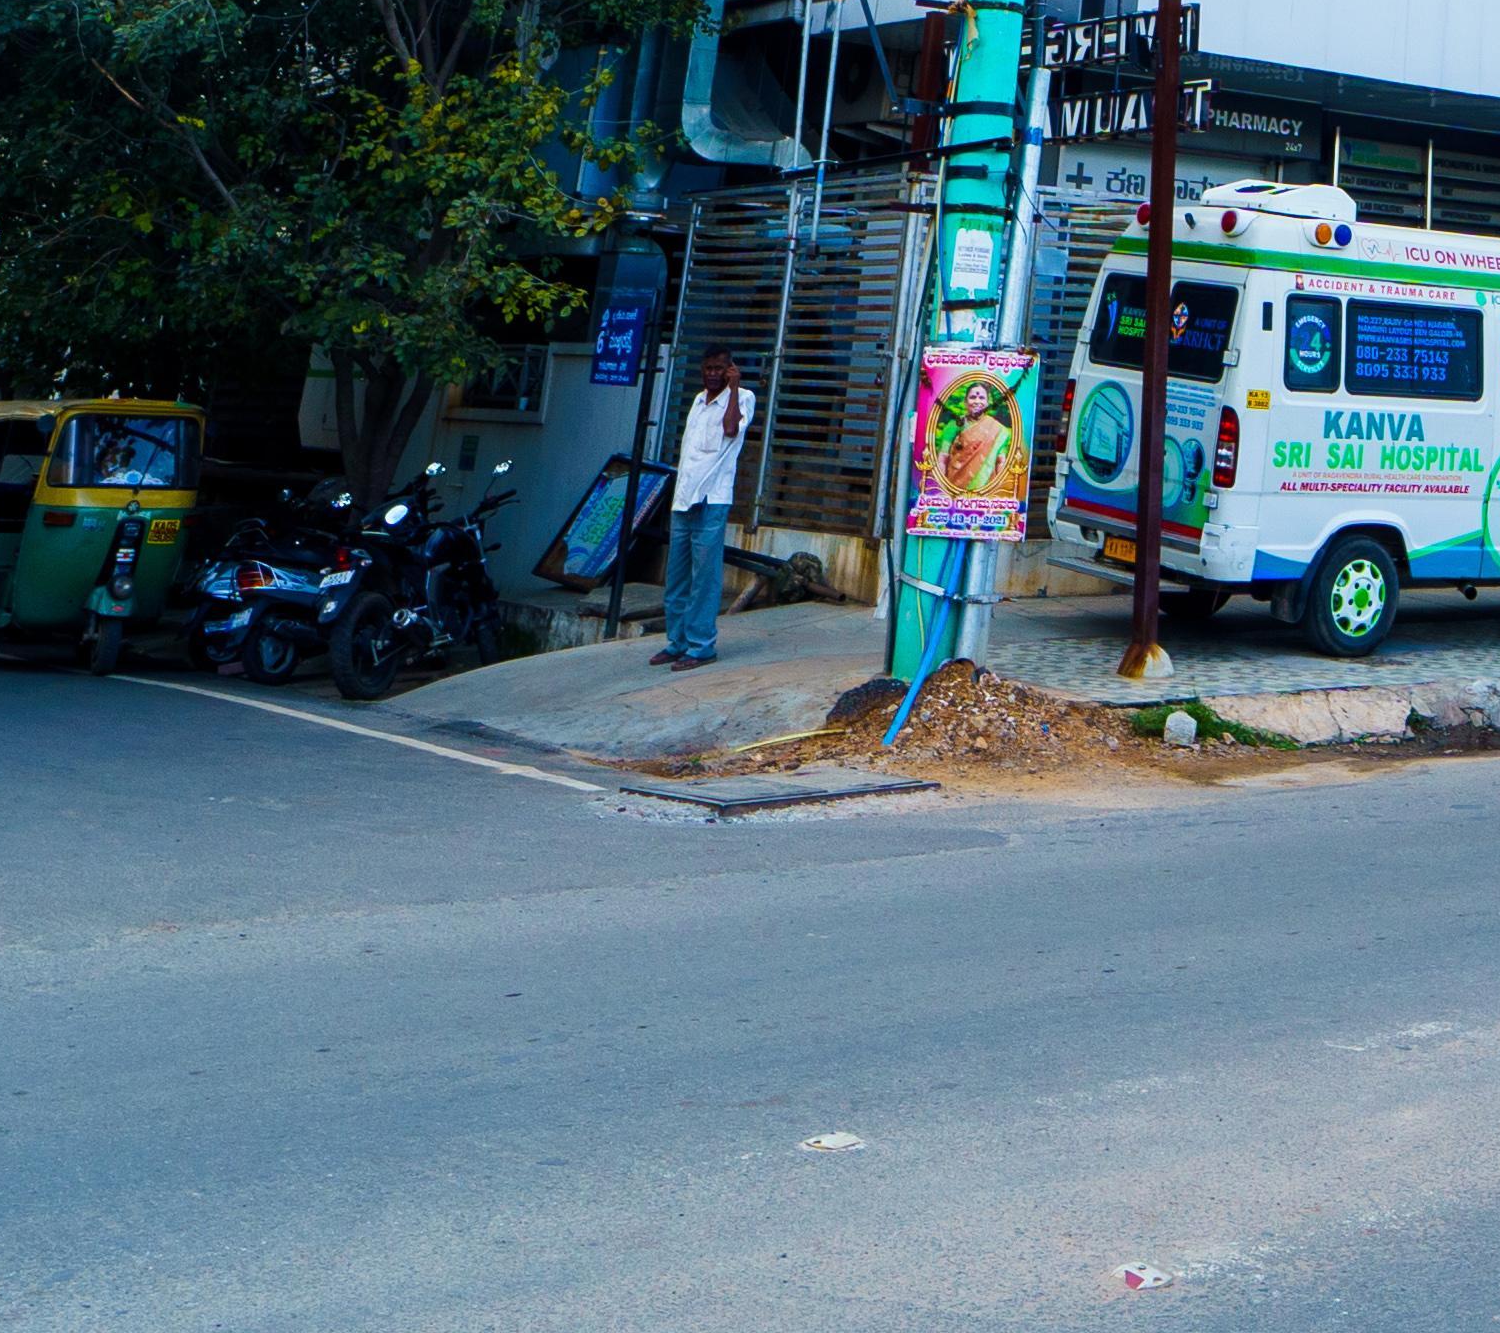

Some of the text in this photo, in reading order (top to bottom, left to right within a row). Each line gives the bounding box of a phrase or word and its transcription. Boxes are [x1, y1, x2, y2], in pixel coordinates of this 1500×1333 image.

[1208, 107, 1302, 137] PHARMACY
[1405, 246, 1430, 262] ICU
[1435, 250, 1457, 265] ON
[1308, 278, 1456, 301] ACCIDENT & TRAUMA CARE
[1298, 331, 1322, 352] 24
[1356, 346, 1449, 365] 080-233 75143
[1356, 363, 1389, 378] 8095
[1422, 367, 1447, 381] 933
[1324, 410, 1425, 442] KANVA
[1272, 441, 1484, 473] SRI SAI HOSPITAL
[1280, 482, 1470, 495] ALL MULTI-SPECIALITY FACILITY AVAILABLE
[952, 514, 1006, 526] 13-11-2021
